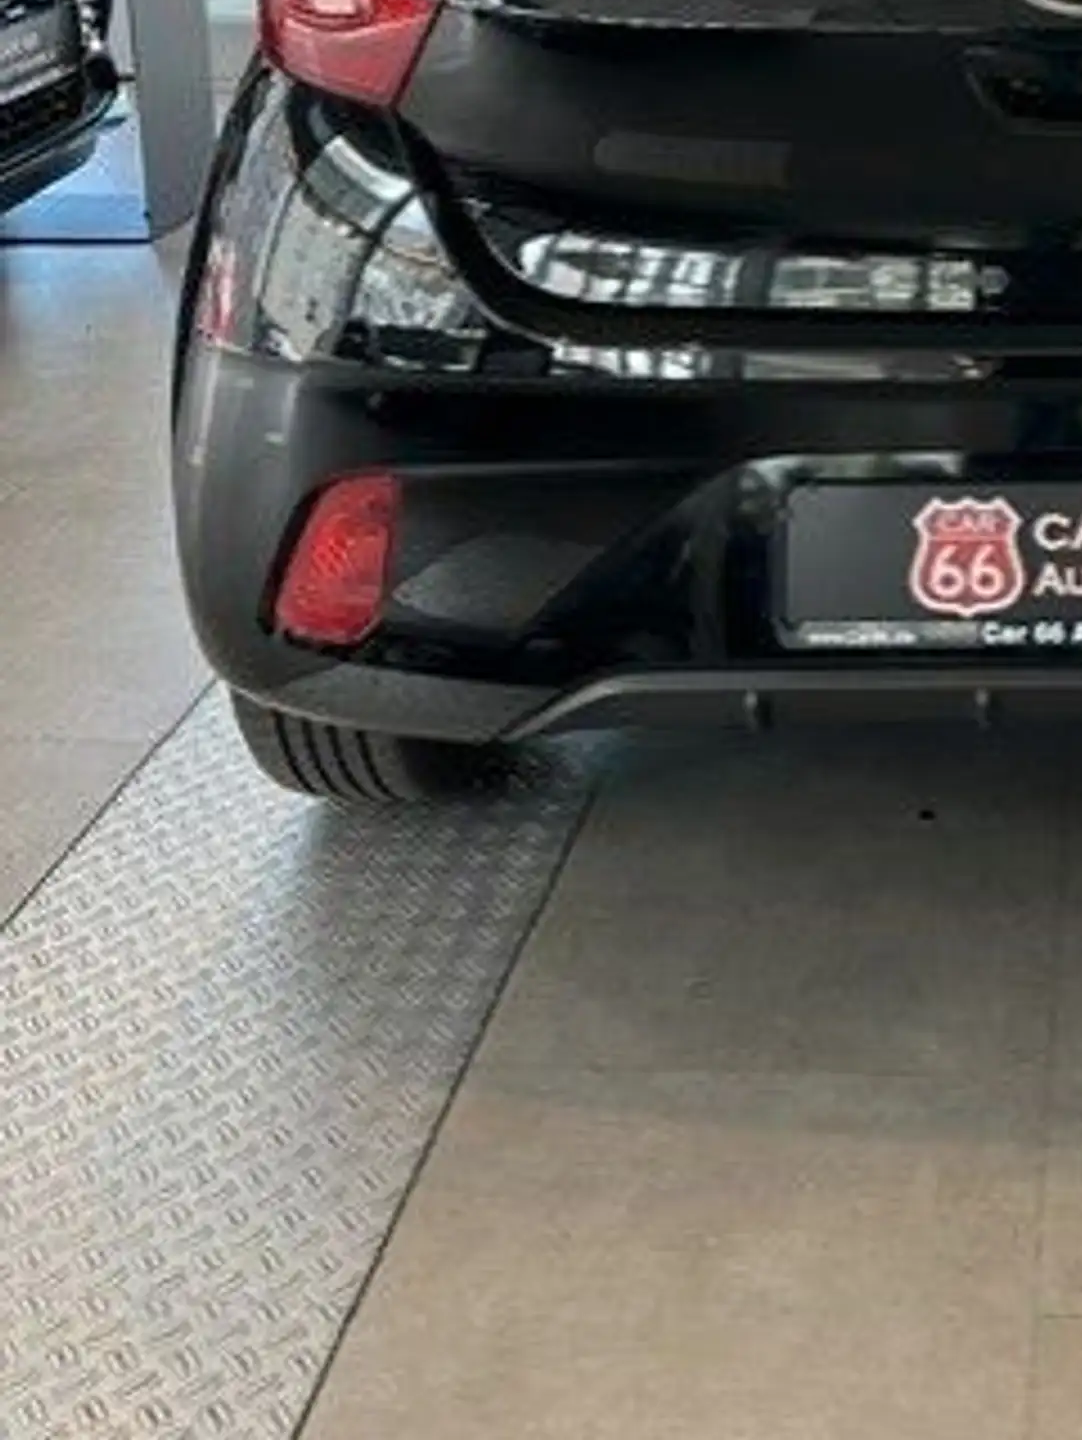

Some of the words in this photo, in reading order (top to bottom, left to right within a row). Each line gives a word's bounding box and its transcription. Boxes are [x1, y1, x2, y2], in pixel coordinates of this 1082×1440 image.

[929, 543, 1006, 599] 66
[981, 620, 1028, 645] Car
[1032, 621, 1065, 644] 66
